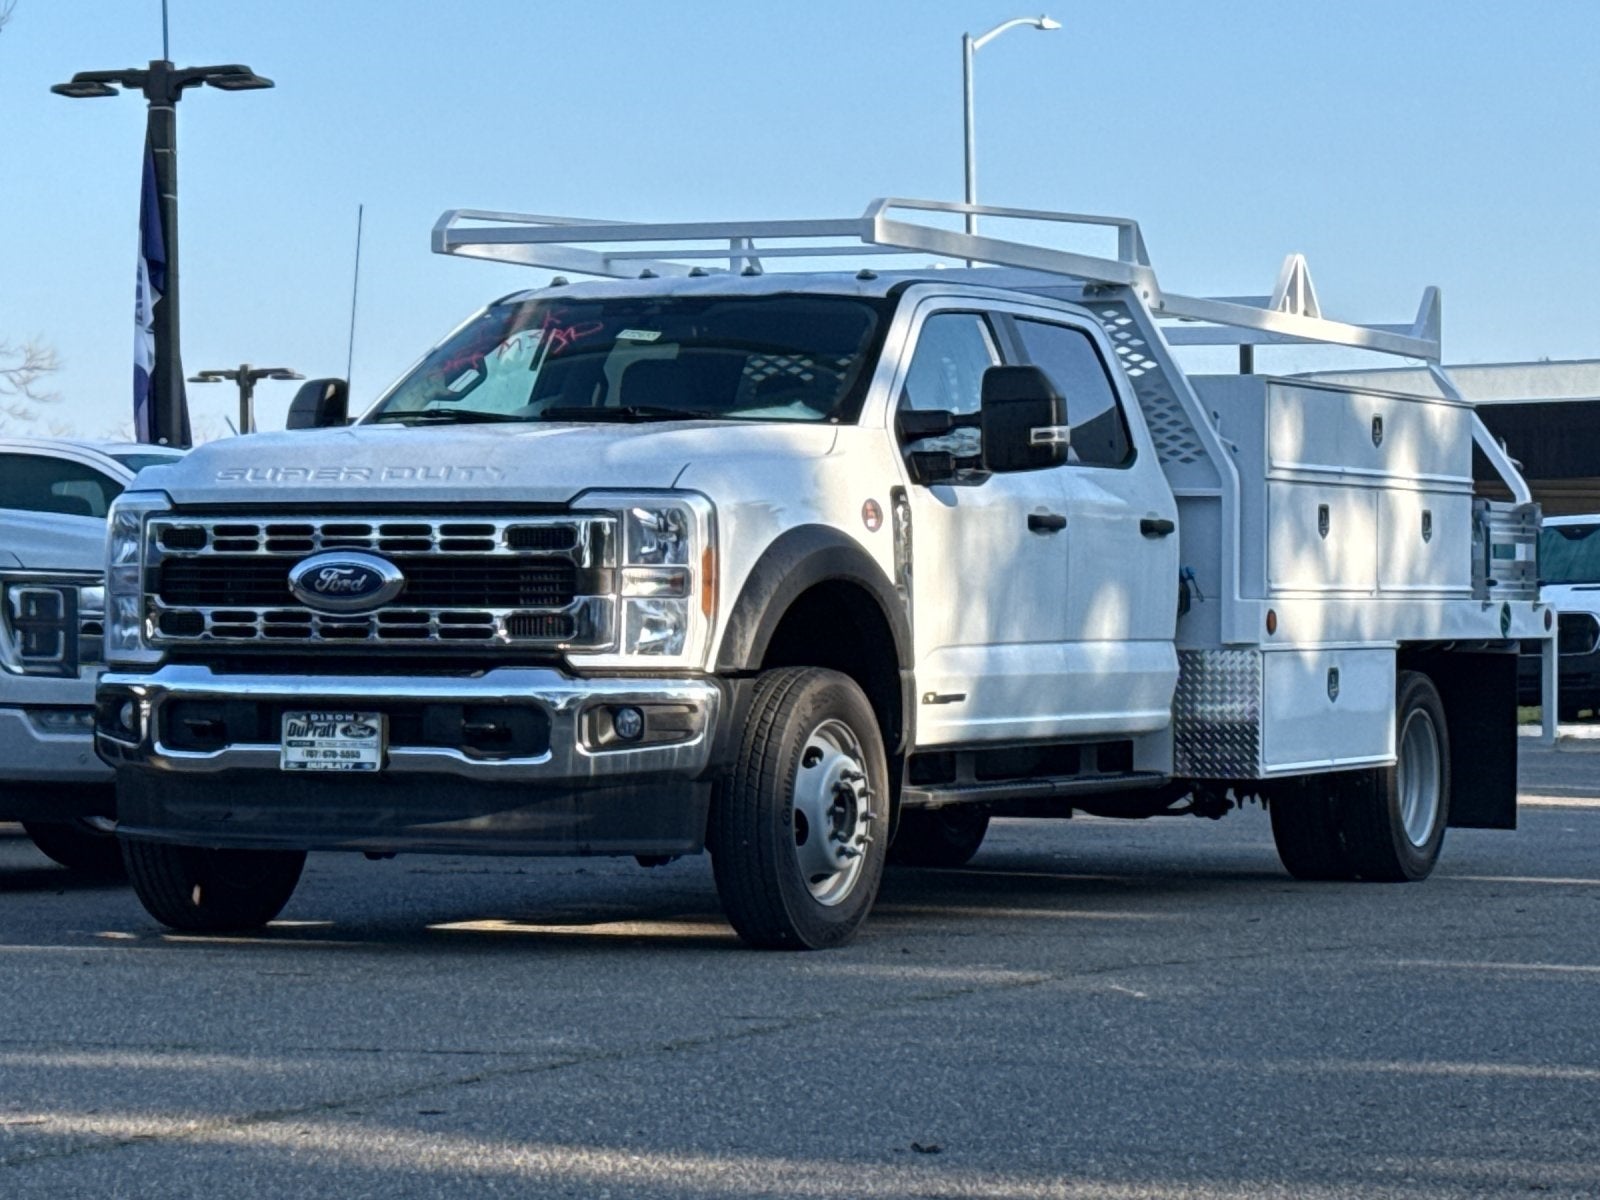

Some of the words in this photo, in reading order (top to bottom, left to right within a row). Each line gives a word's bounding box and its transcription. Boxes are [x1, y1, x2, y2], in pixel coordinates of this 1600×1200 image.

[215, 465, 374, 482] SUPER
[380, 465, 515, 482] DUTY
[314, 567, 368, 592] Ford
[310, 713, 354, 721] DIXON
[287, 721, 338, 738] DuPratt
